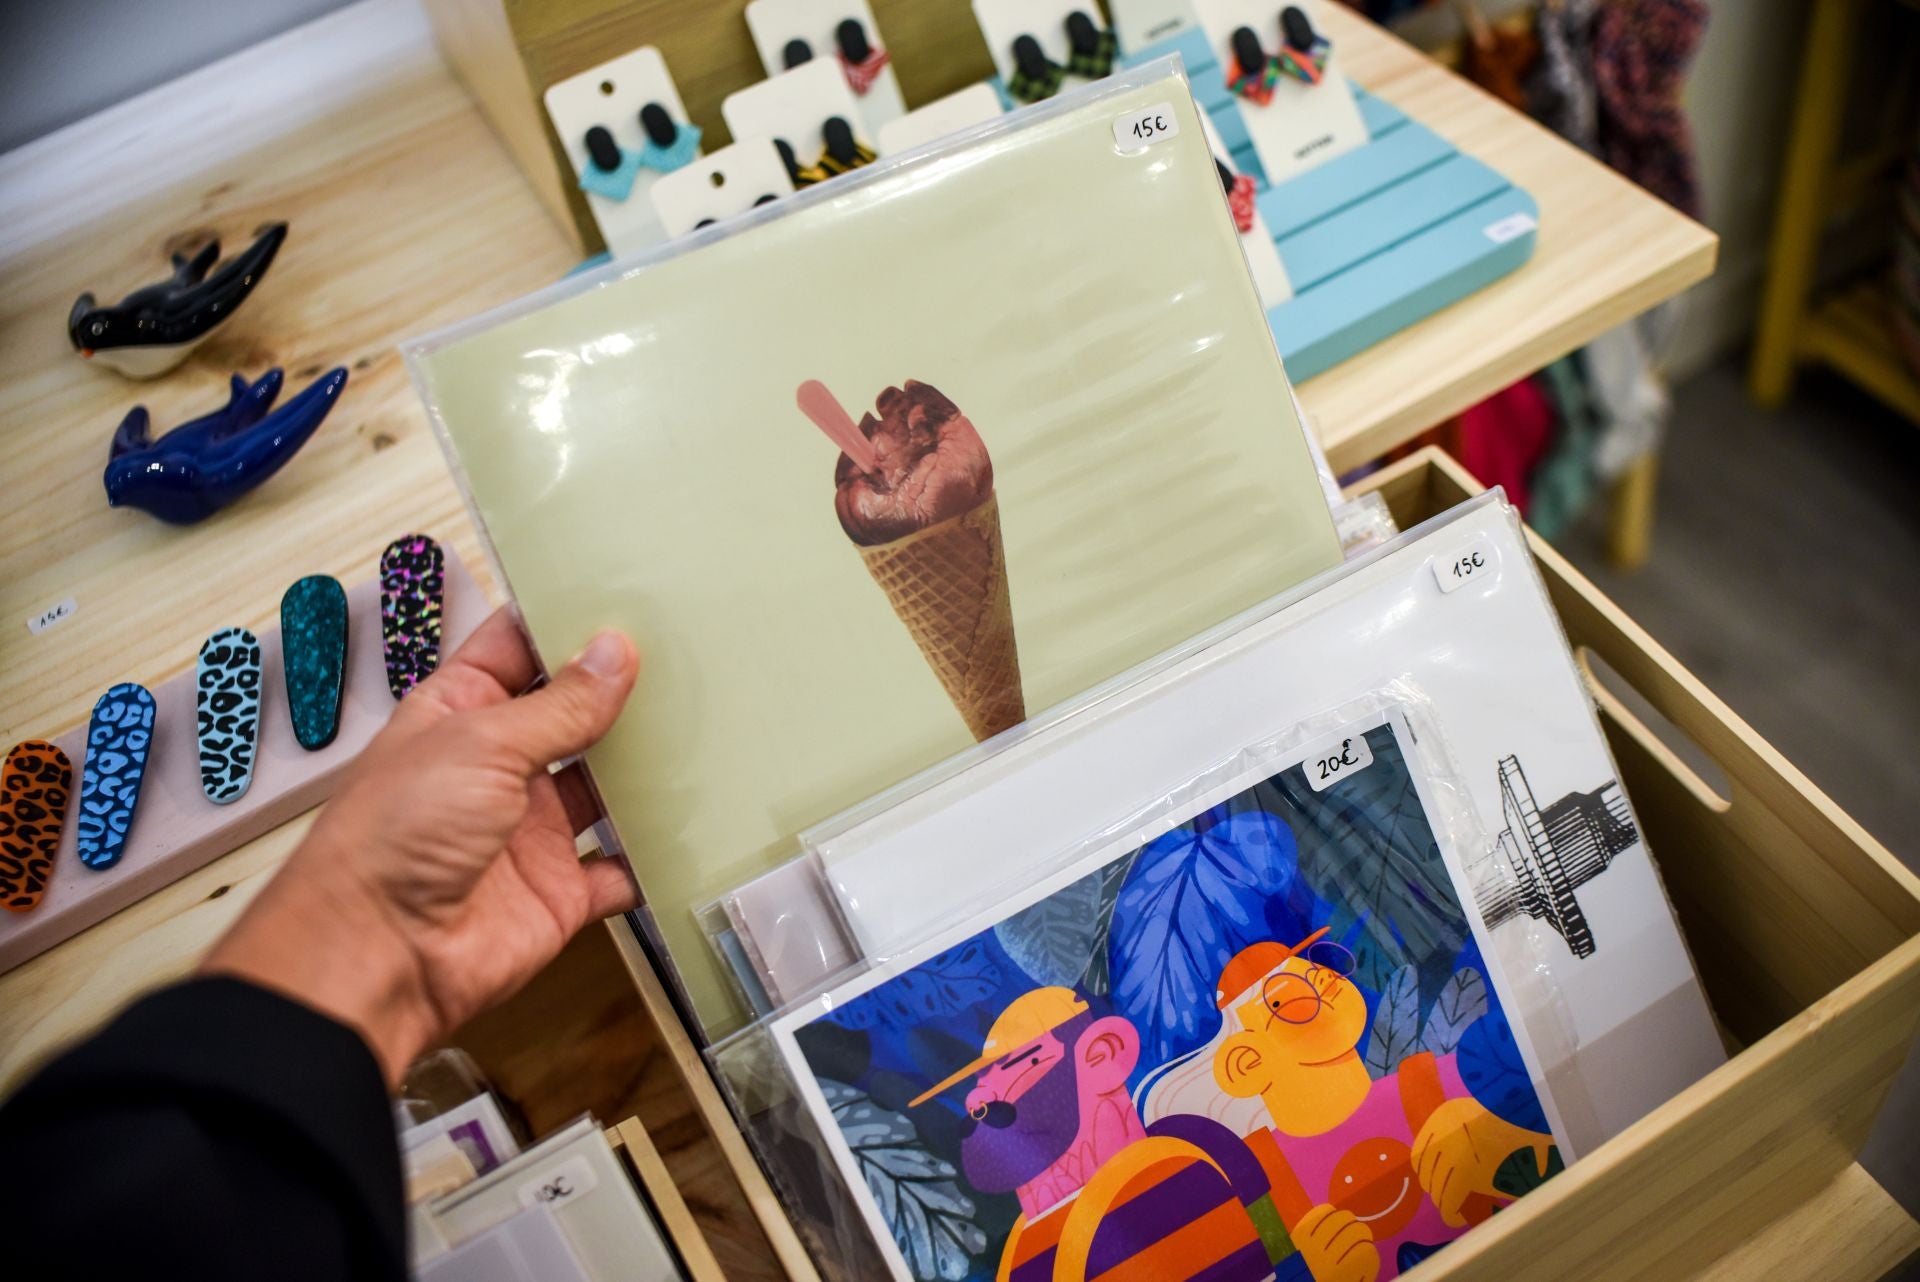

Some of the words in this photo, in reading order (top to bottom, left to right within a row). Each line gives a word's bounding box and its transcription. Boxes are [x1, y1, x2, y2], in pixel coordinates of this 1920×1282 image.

[1133, 116, 1167, 138] 15€
[1453, 552, 1484, 577] 15€
[1316, 738, 1359, 779] 20€
